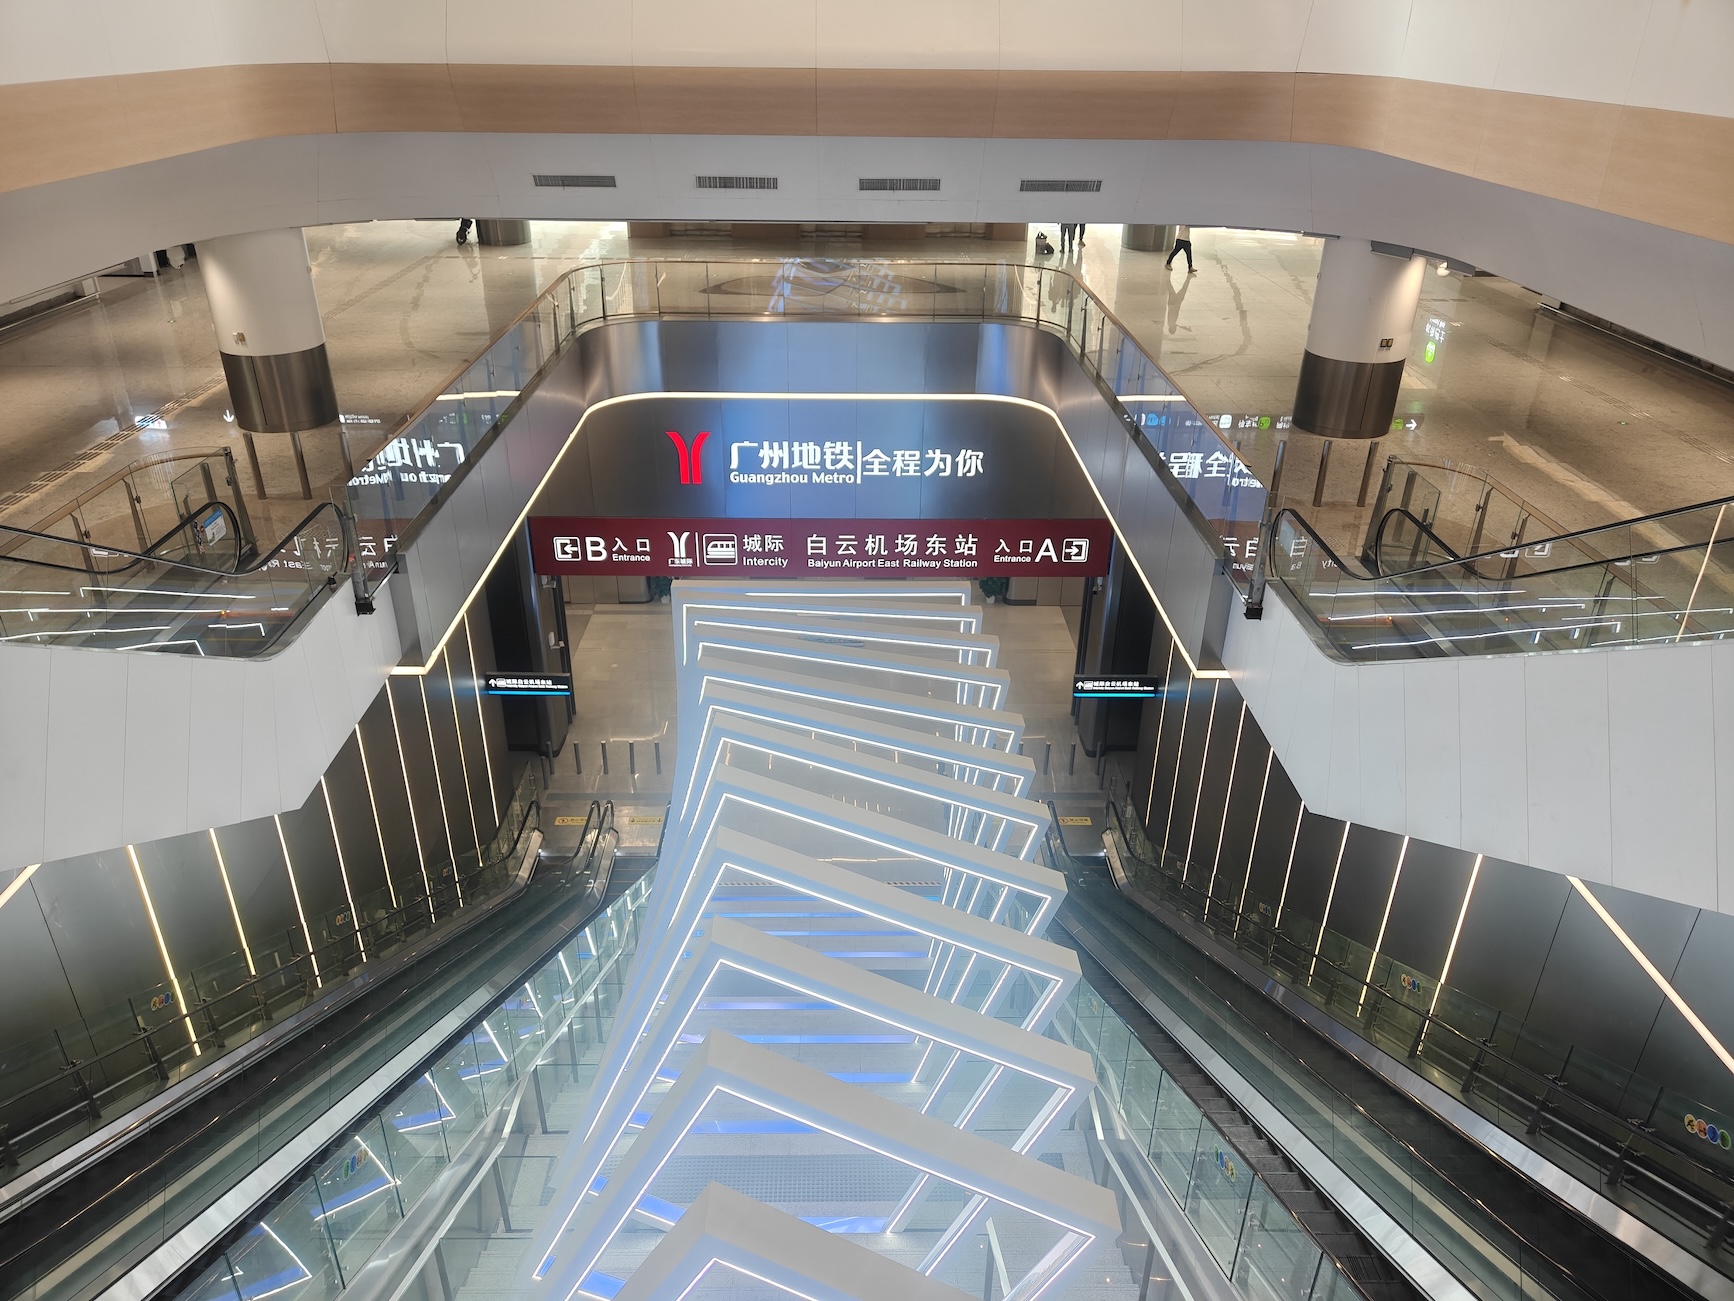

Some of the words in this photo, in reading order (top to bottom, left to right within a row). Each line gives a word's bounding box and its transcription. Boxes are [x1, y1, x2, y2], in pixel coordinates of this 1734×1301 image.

[729, 440, 855, 470] 广州地铁
[862, 448, 984, 477] 全程为你
[729, 471, 808, 486] Guangzhou
[811, 472, 855, 484] Metro
[585, 537, 607, 561] B
[611, 537, 651, 552] 入口
[742, 534, 785, 553] 城际
[806, 533, 979, 556] 白云机场东站
[994, 539, 1034, 554] 入口
[1034, 538, 1059, 563] A
[612, 553, 650, 562] Entrance
[742, 556, 788, 568] Intercity
[807, 558, 841, 568] Baiyun
[842, 558, 876, 568] Airport
[877, 559, 900, 567] East
[903, 559, 941, 569] Railway
[943, 559, 978, 567] Station
[993, 555, 1031, 563] Entrance
